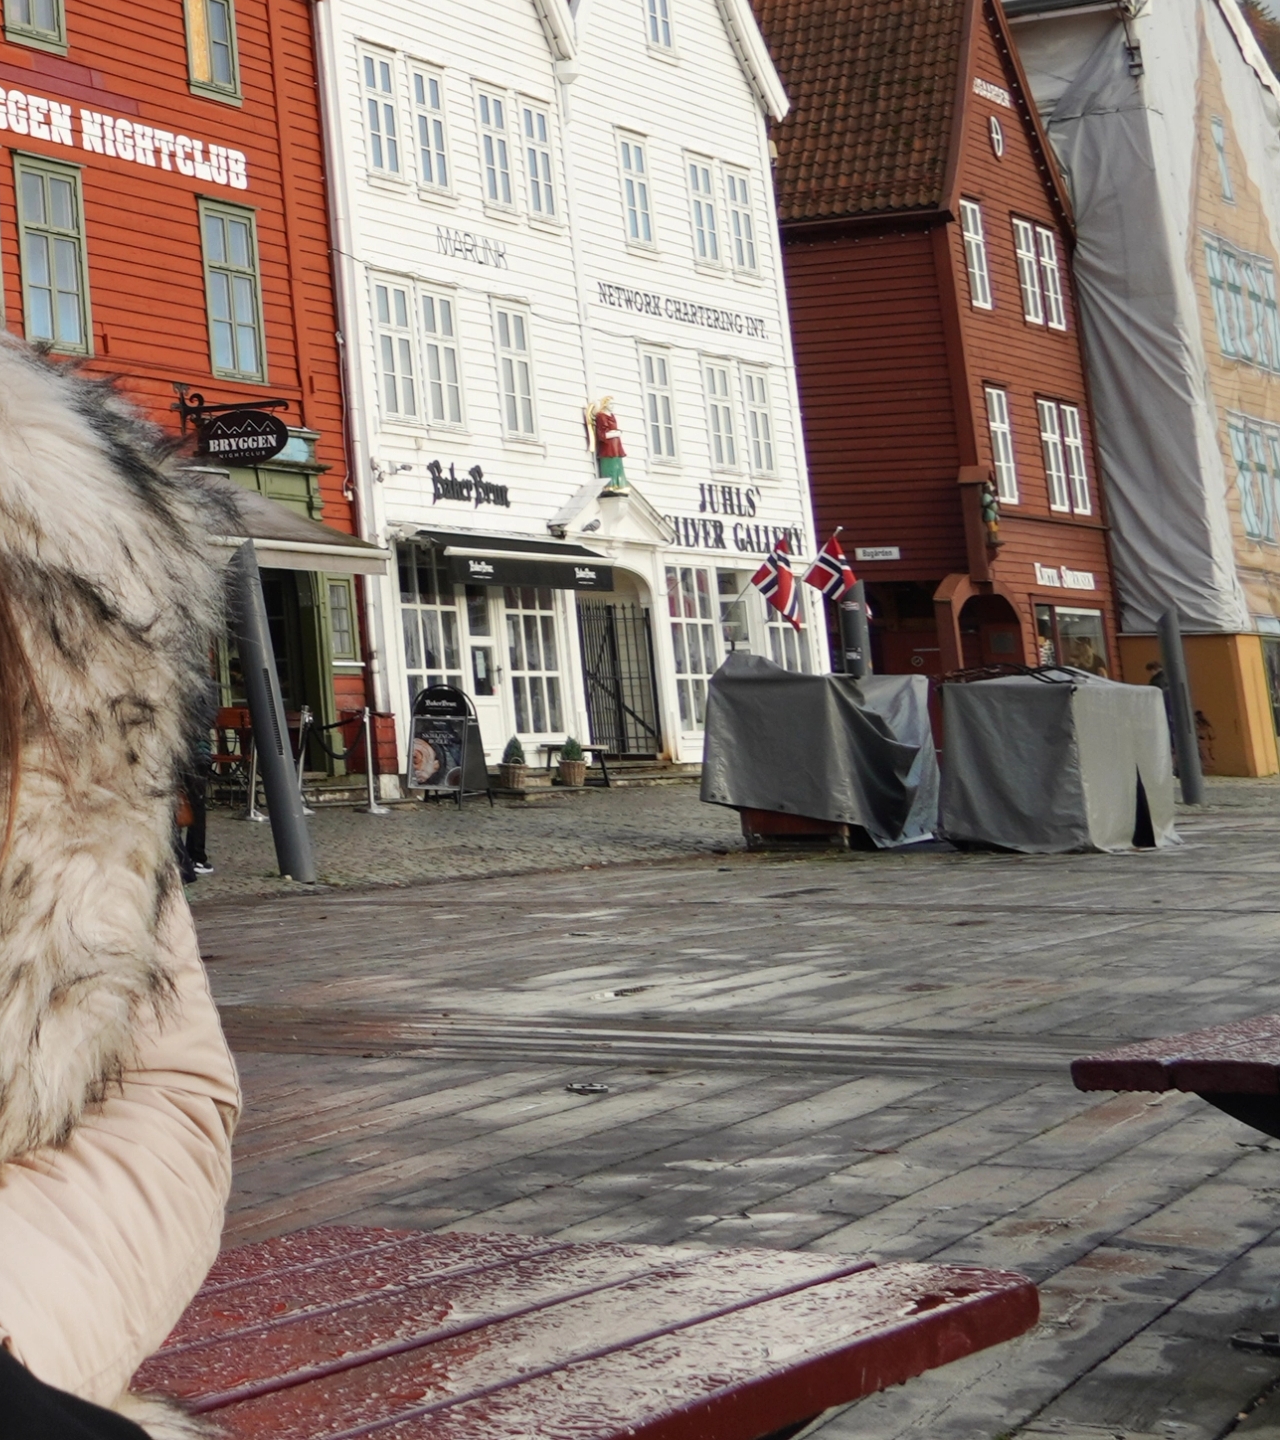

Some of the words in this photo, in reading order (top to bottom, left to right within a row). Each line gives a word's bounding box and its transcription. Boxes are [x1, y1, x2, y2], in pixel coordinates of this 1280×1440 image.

[80, 108, 247, 190] NIGHTCLUB
[597, 282, 662, 317] NETWORK
[664, 298, 743, 334] CHARTERING
[745, 316, 769, 340] INT.
[209, 434, 277, 452] BRYGGEN
[219, 450, 266, 459] NIGHTCLUB
[663, 514, 727, 549] SILVER
